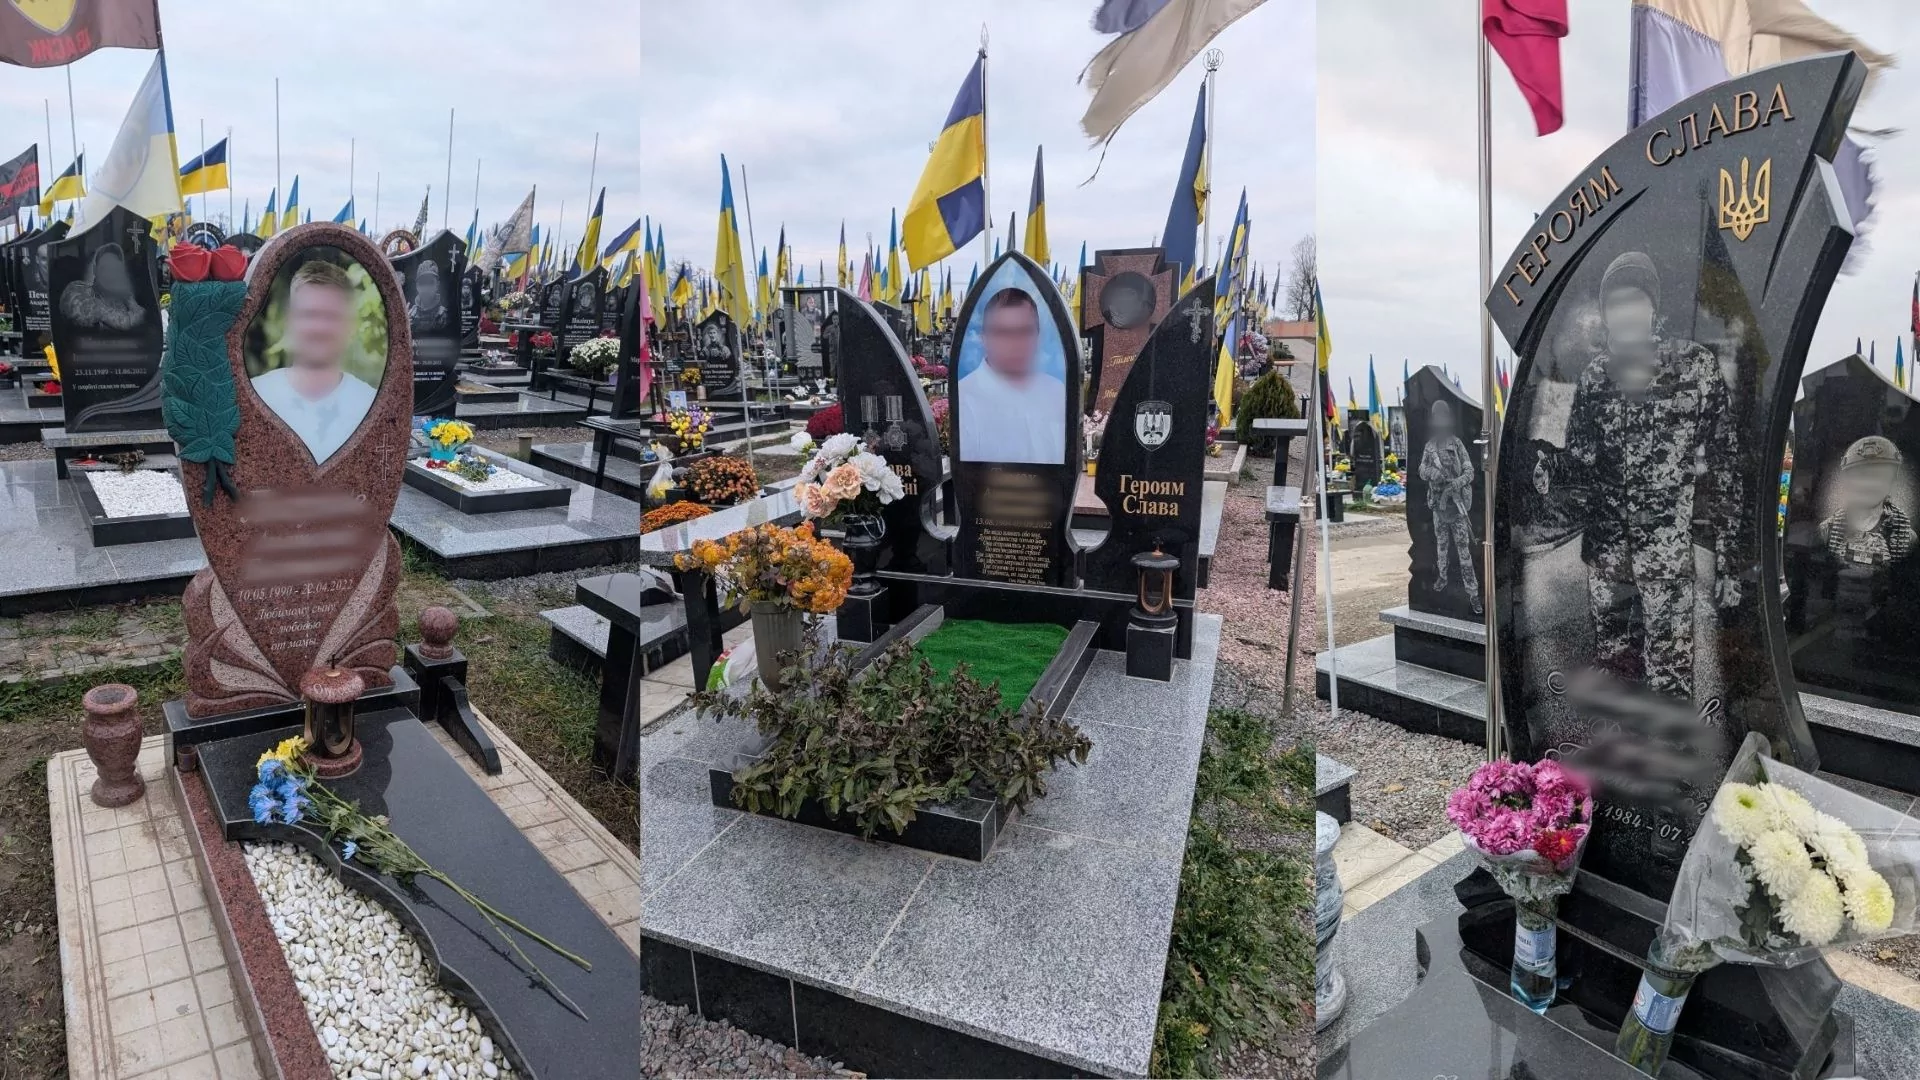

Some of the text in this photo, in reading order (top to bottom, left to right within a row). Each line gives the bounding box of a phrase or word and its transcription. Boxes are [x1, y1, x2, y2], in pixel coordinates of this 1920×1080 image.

[1503, 82, 1795, 306] ГЕРОЯМ СЛАВА
[1119, 474, 1185, 499] Героям
[1122, 494, 1179, 516] Слава
